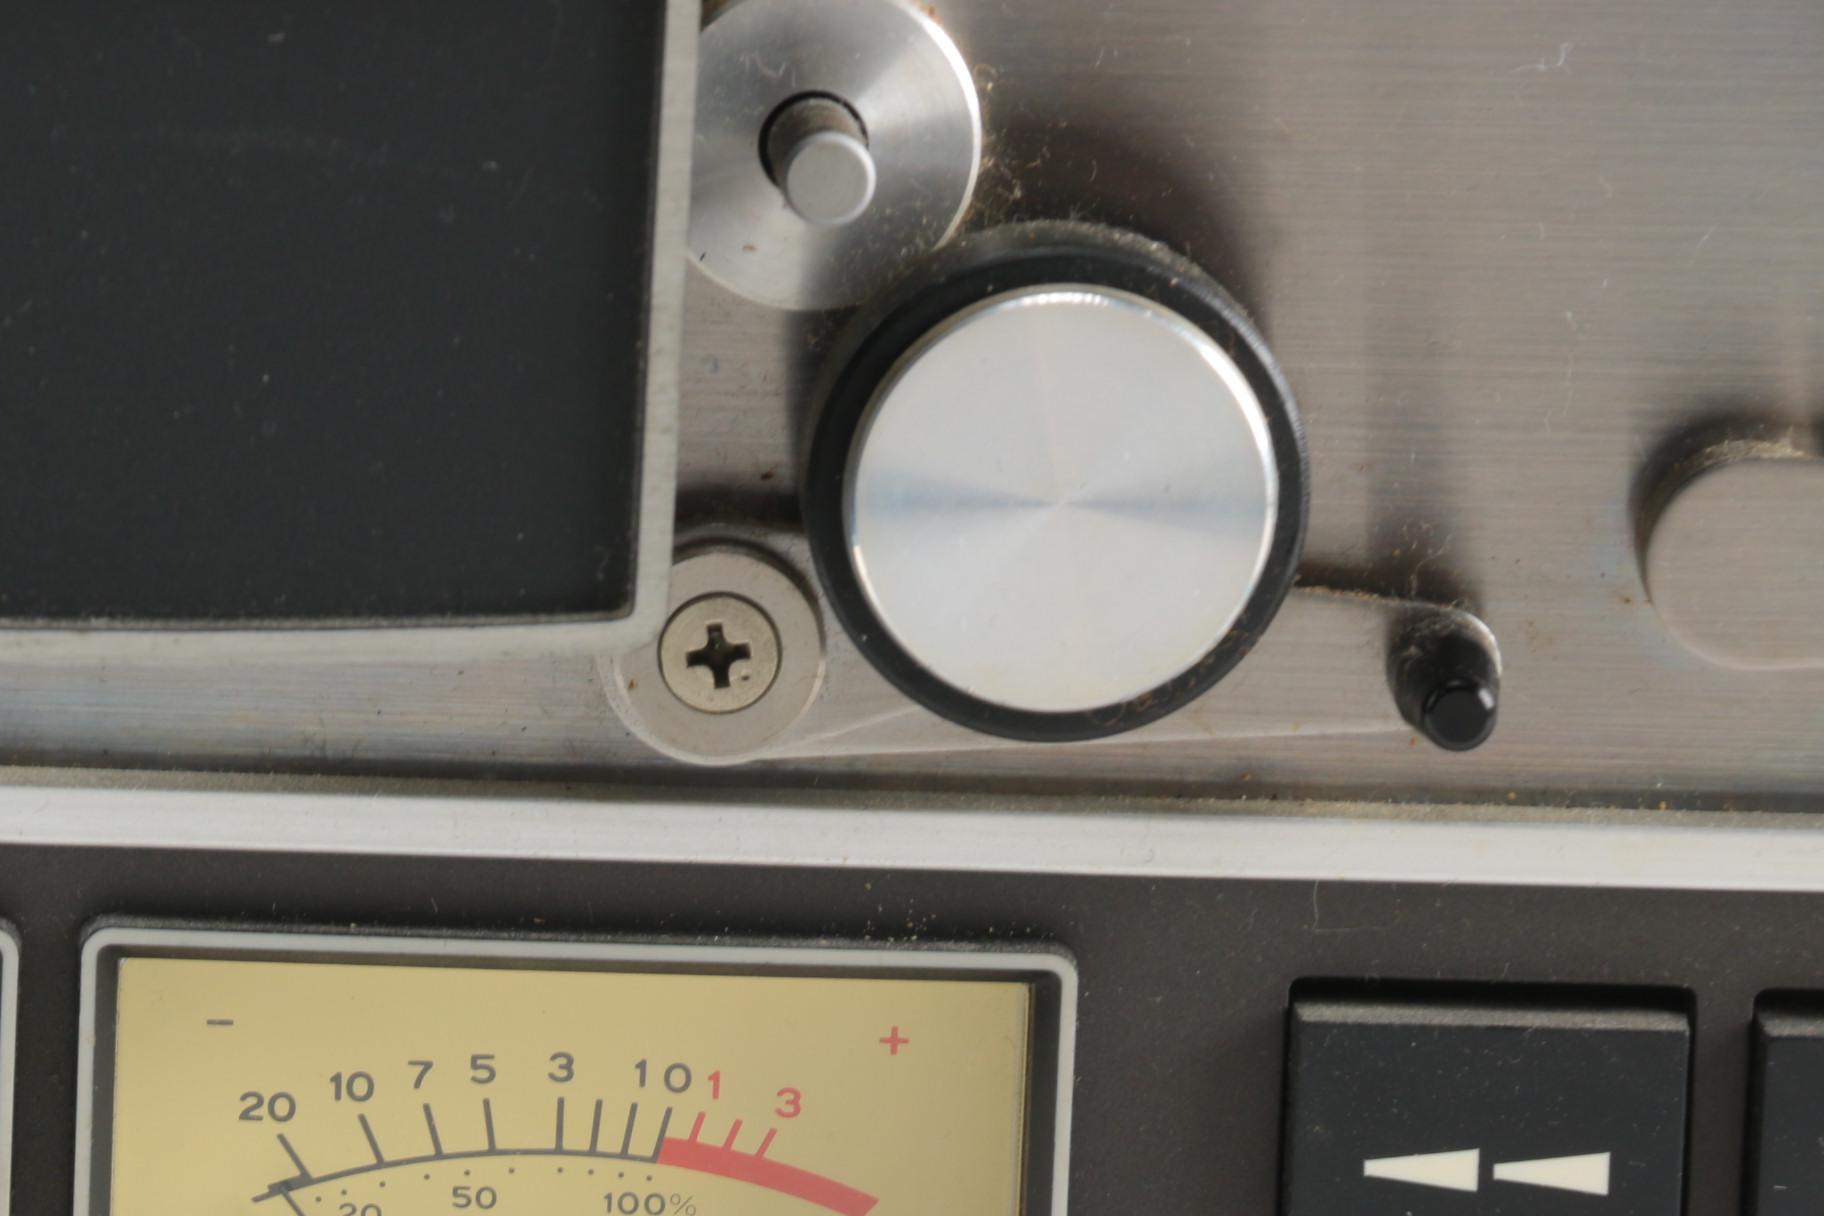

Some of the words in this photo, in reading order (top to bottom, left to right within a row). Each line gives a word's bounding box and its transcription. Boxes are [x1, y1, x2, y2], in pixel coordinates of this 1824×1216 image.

[237, 1090, 297, 1123] 20
[328, 1070, 376, 1103] 10
[406, 1059, 434, 1090] 7
[469, 1053, 497, 1085] 5
[547, 1051, 575, 1083] 3
[775, 1086, 803, 1119] 3
[451, 1185, 498, 1210] 50
